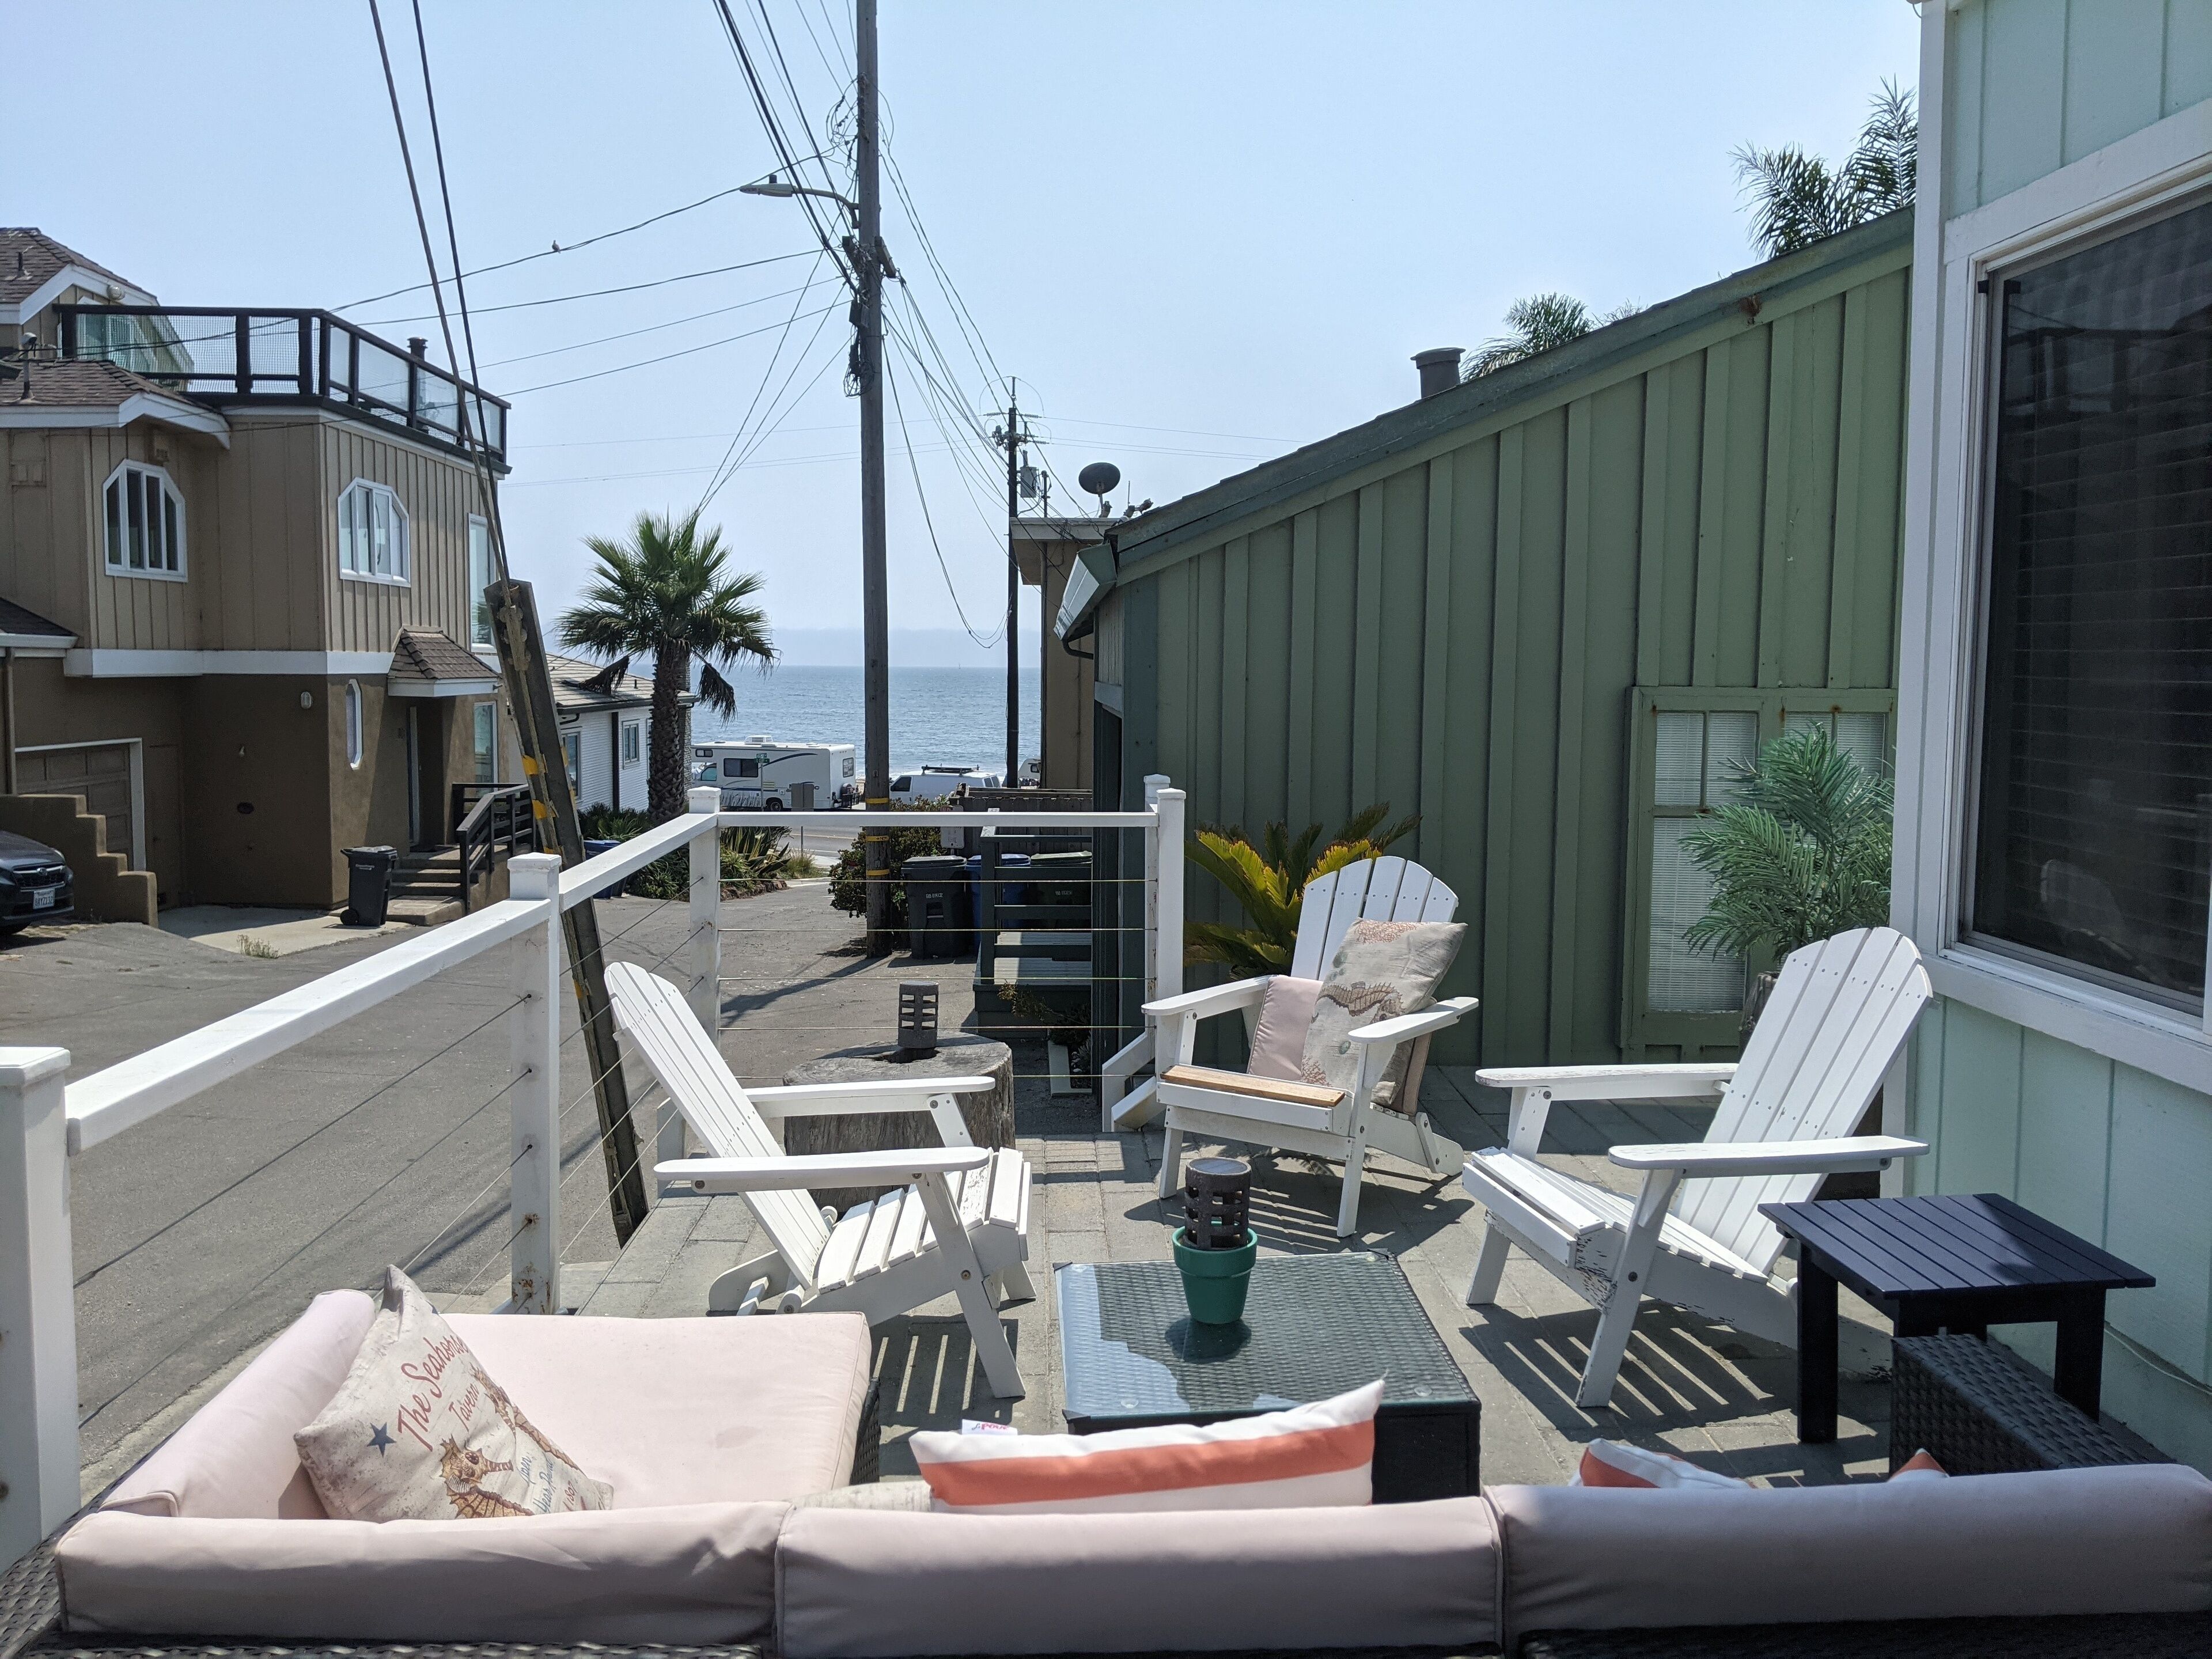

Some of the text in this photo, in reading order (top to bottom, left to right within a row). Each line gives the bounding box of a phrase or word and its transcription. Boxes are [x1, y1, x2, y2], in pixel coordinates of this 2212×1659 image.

[397, 1334, 469, 1452] The Seahorse
[448, 1383, 480, 1433] Tavern
[532, 1488, 553, 1514] Year
